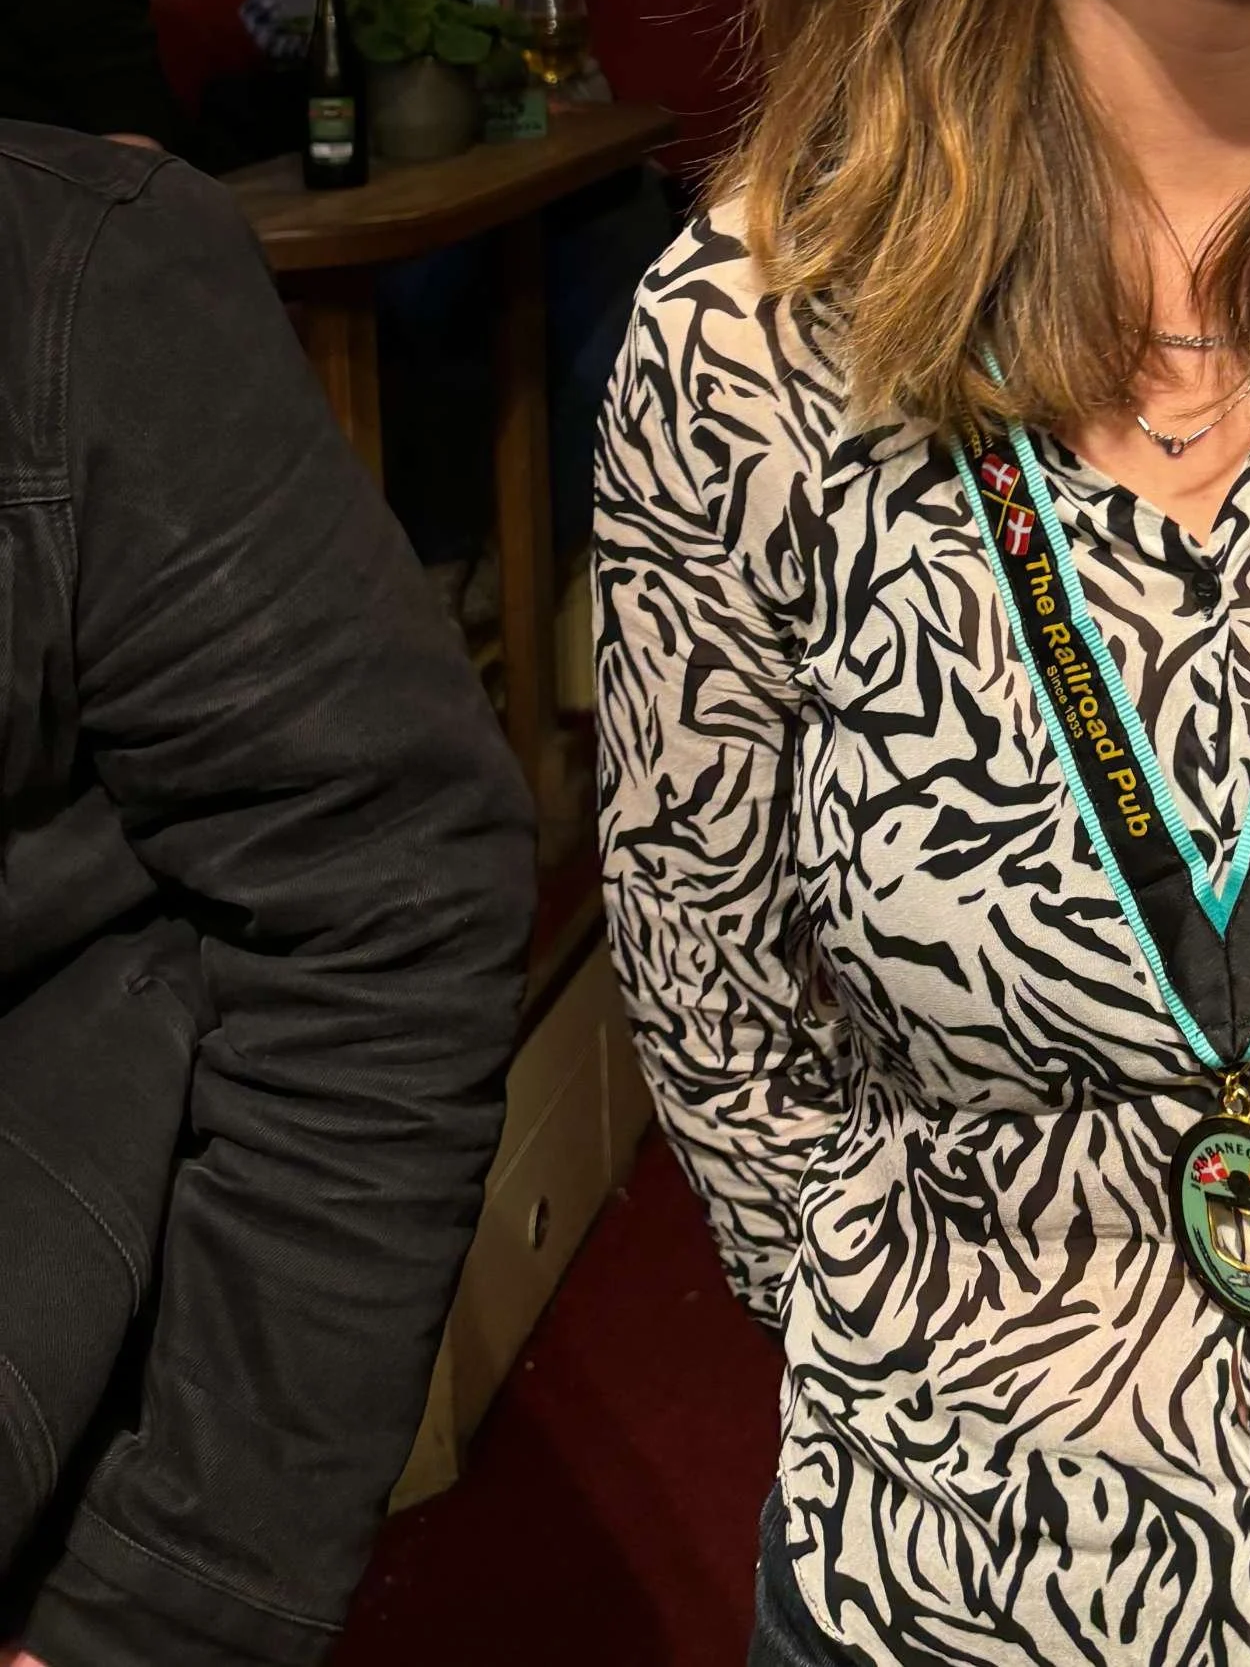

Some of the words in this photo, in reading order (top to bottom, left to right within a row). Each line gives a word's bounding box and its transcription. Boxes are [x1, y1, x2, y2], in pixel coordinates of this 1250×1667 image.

[1025, 553, 1056, 617] The
[1042, 622, 1125, 762] Railroad
[1107, 767, 1152, 838] Pub
[1064, 704, 1085, 739] 1933
